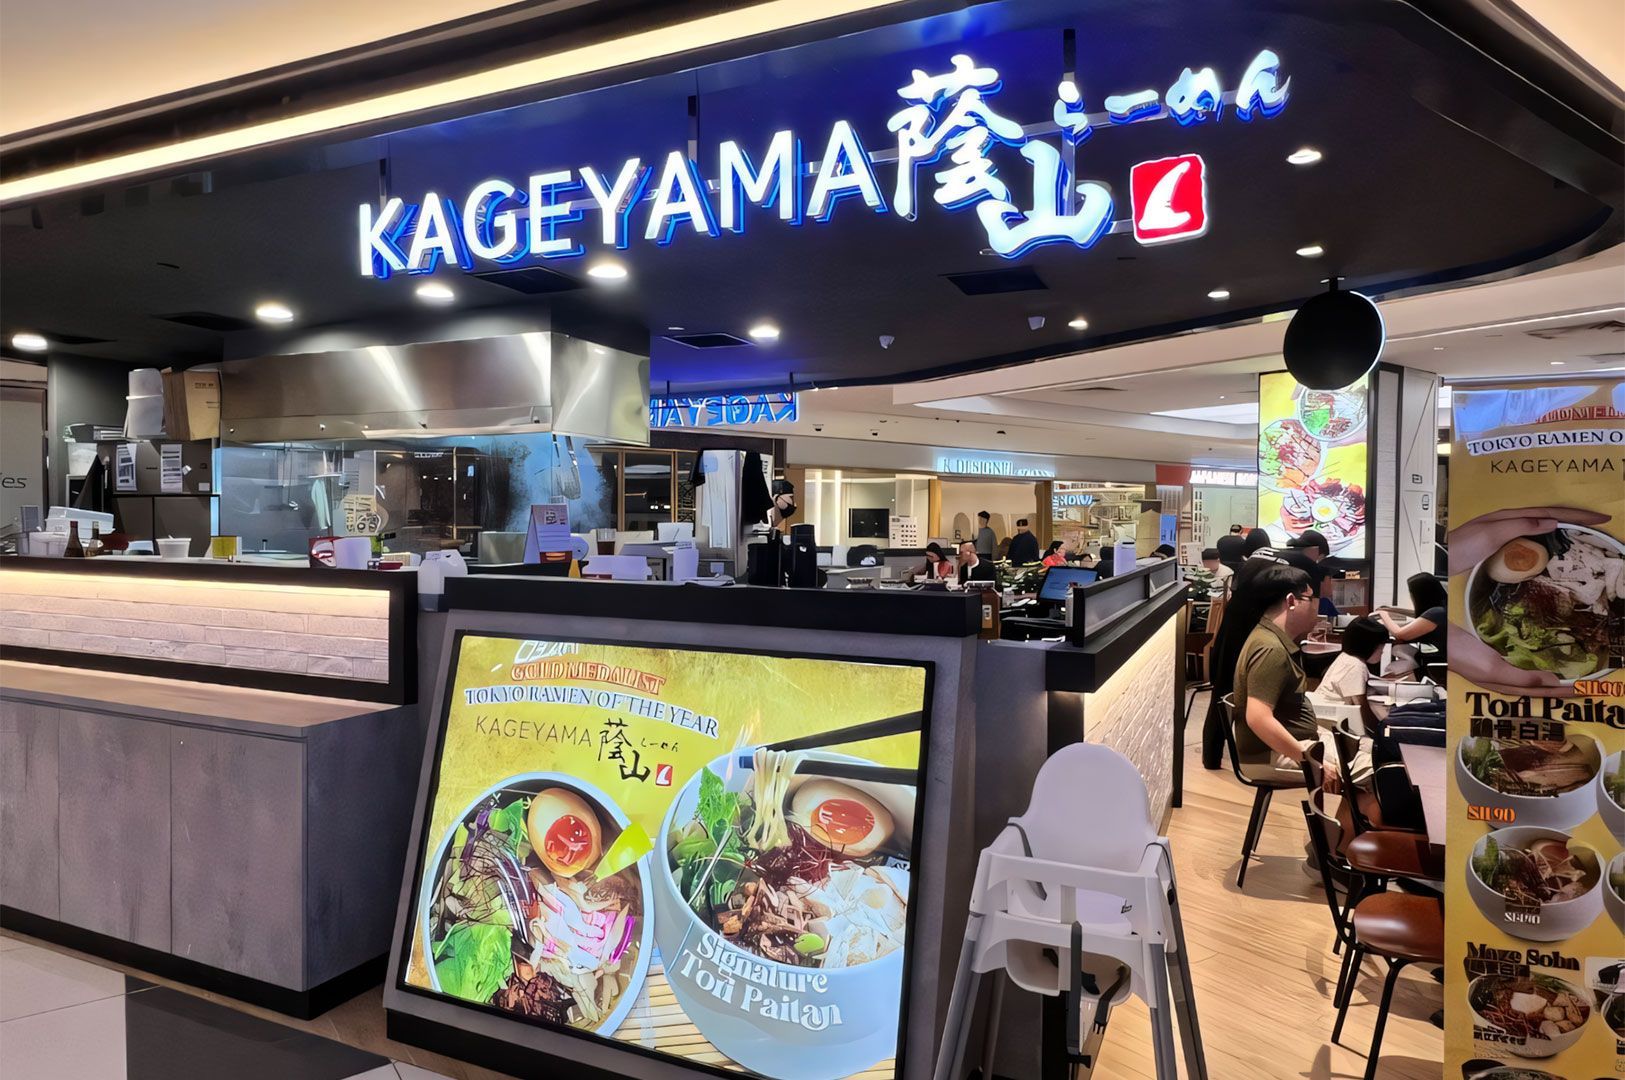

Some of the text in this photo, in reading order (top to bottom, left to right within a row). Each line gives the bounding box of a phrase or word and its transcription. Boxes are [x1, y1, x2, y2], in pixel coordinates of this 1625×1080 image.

[1053, 49, 1290, 143] らーめん
[887, 53, 1112, 257] 蔭山
[359, 119, 882, 277] KAGEYAMA
[1469, 435, 1532, 454] TOKYO
[1538, 431, 1604, 446] RAMEN
[0, 472, 27, 488] es
[1490, 458, 1615, 474] KAGEYAMA
[511, 661, 666, 695] GOLD MEDALIST
[465, 687, 719, 738] TOKYO RAMEN OF THE YEAR
[1466, 691, 1532, 719] Tori
[475, 716, 592, 747] KAGEYAMA
[697, 932, 829, 994] Signature
[680, 949, 843, 1031] Tori Paitan
